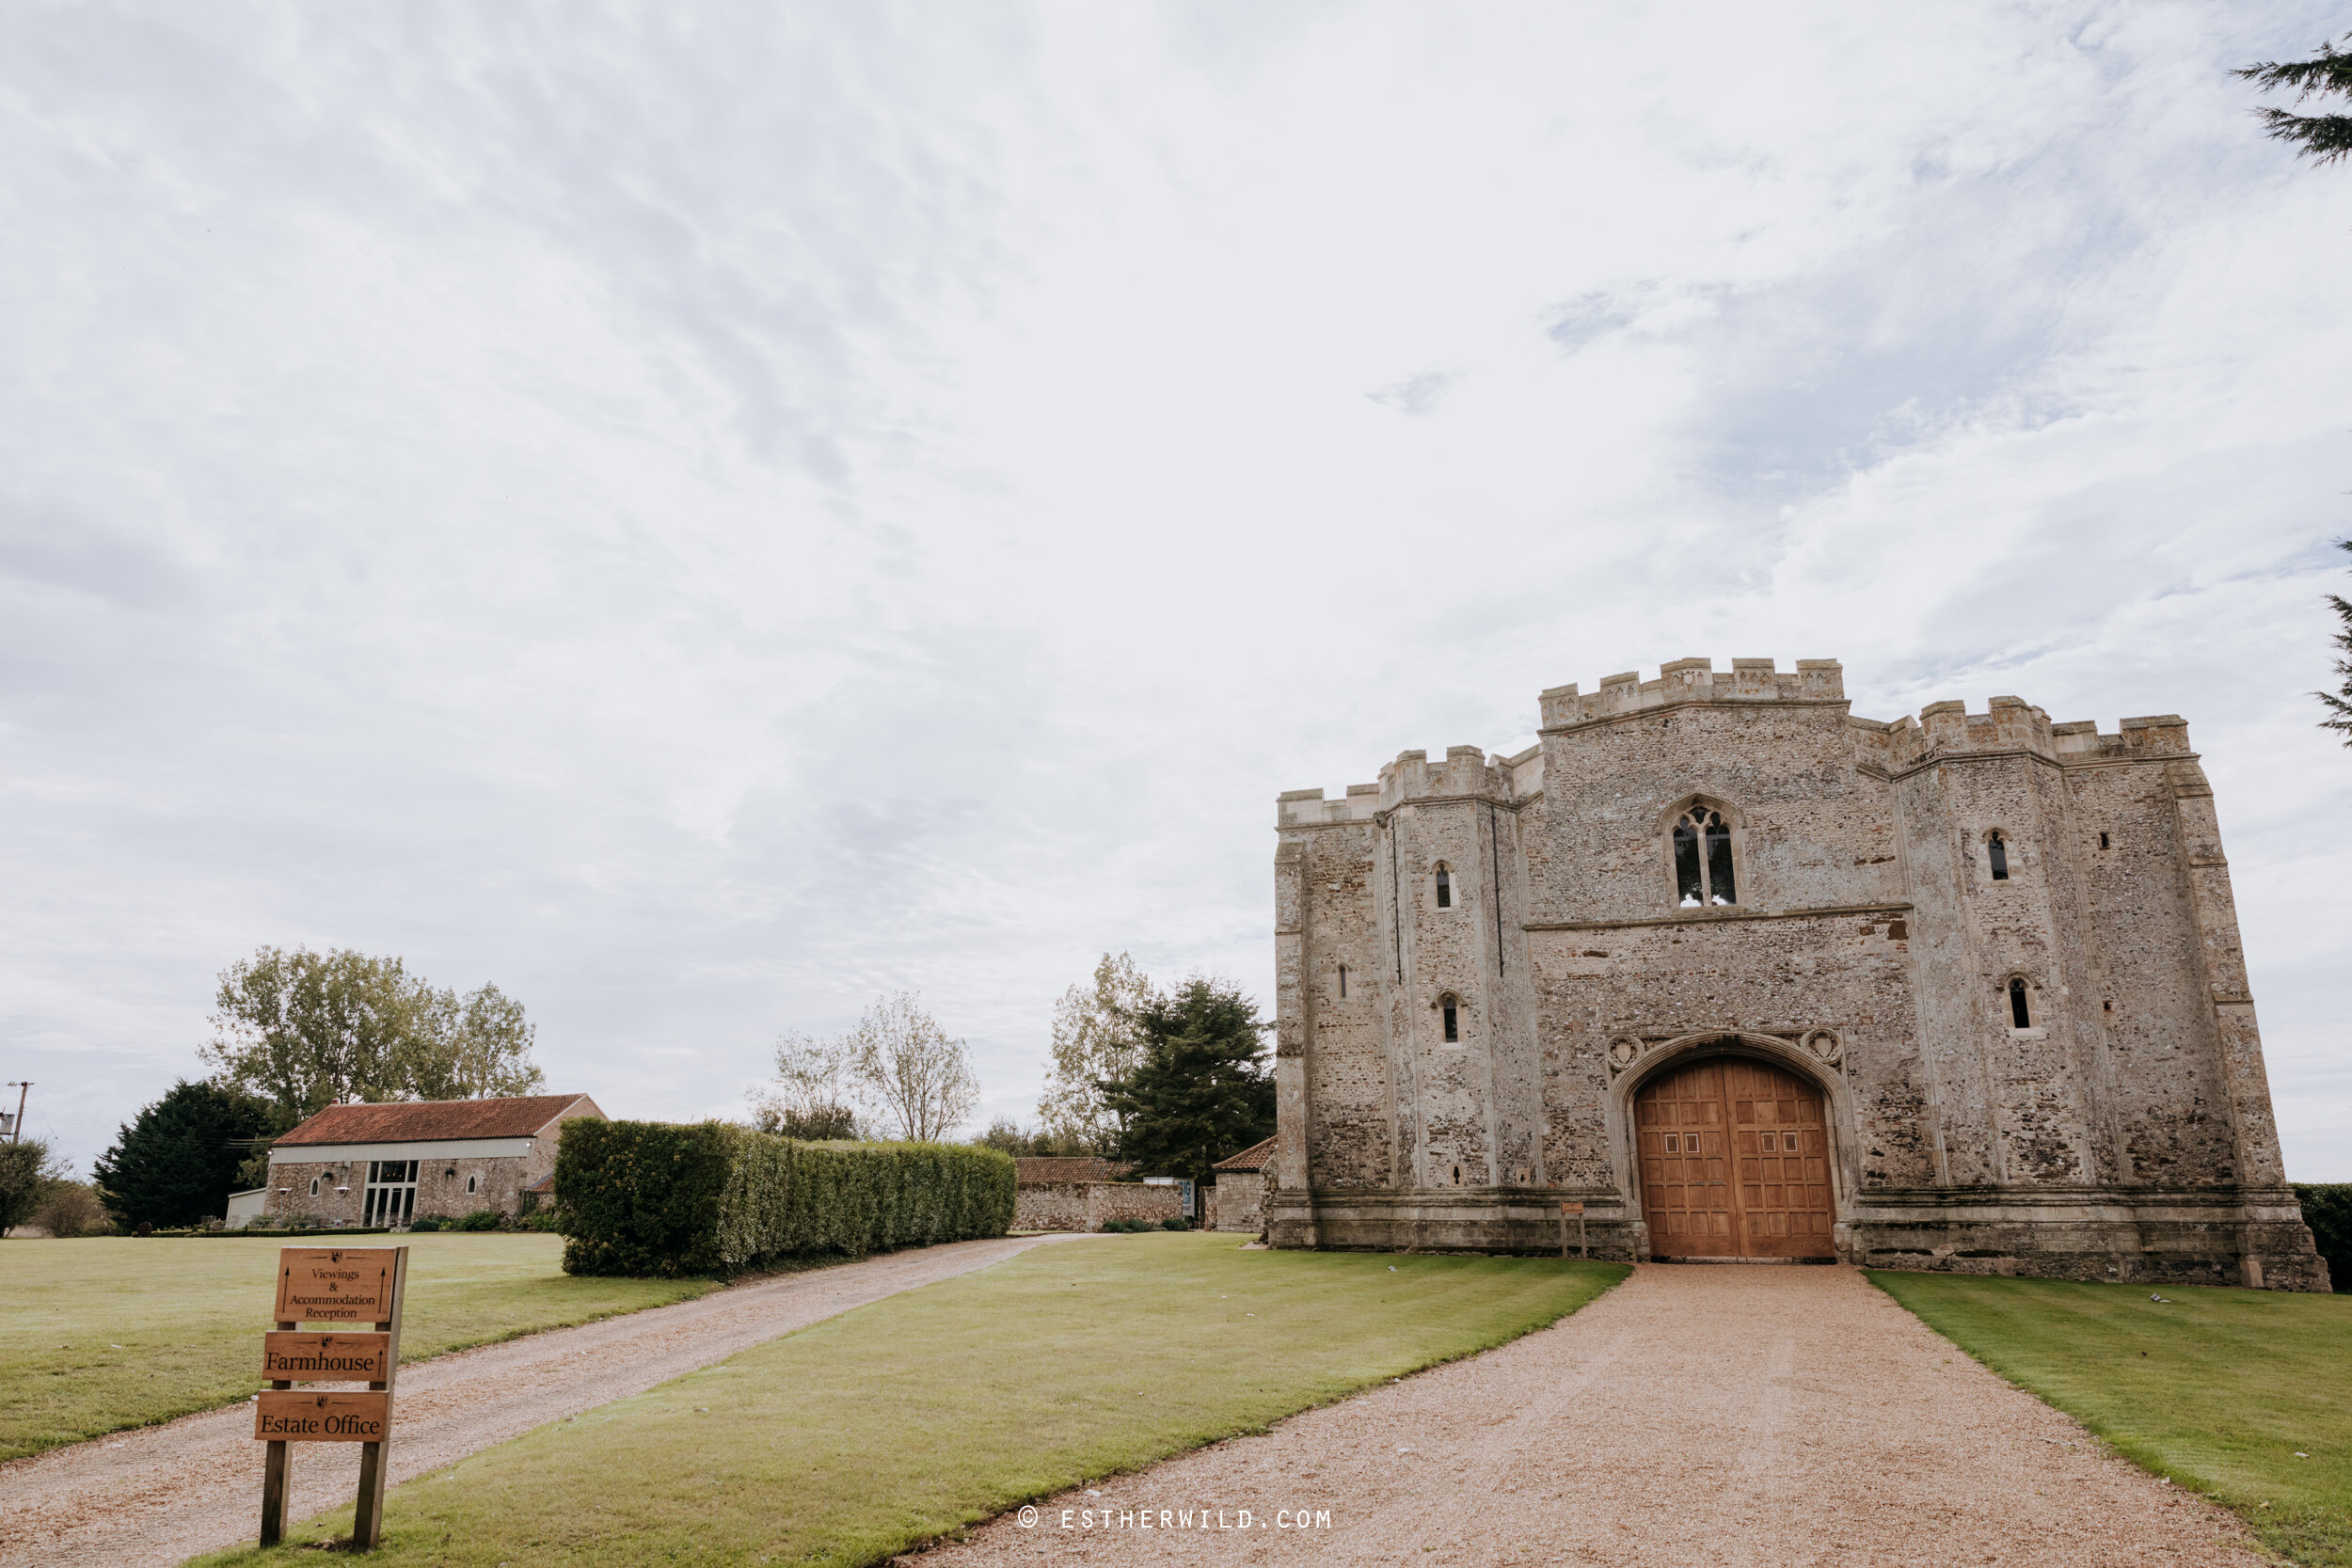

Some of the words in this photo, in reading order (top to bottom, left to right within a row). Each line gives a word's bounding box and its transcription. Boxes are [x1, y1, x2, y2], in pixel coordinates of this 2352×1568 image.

[311, 1268, 360, 1281] Viewings
[328, 1281, 338, 1292] &
[290, 1294, 375, 1306] Accommodation
[306, 1307, 358, 1321] Reception
[265, 1352, 374, 1371] Farmhouse
[261, 1415, 319, 1433] Estate
[325, 1414, 380, 1434] Office
